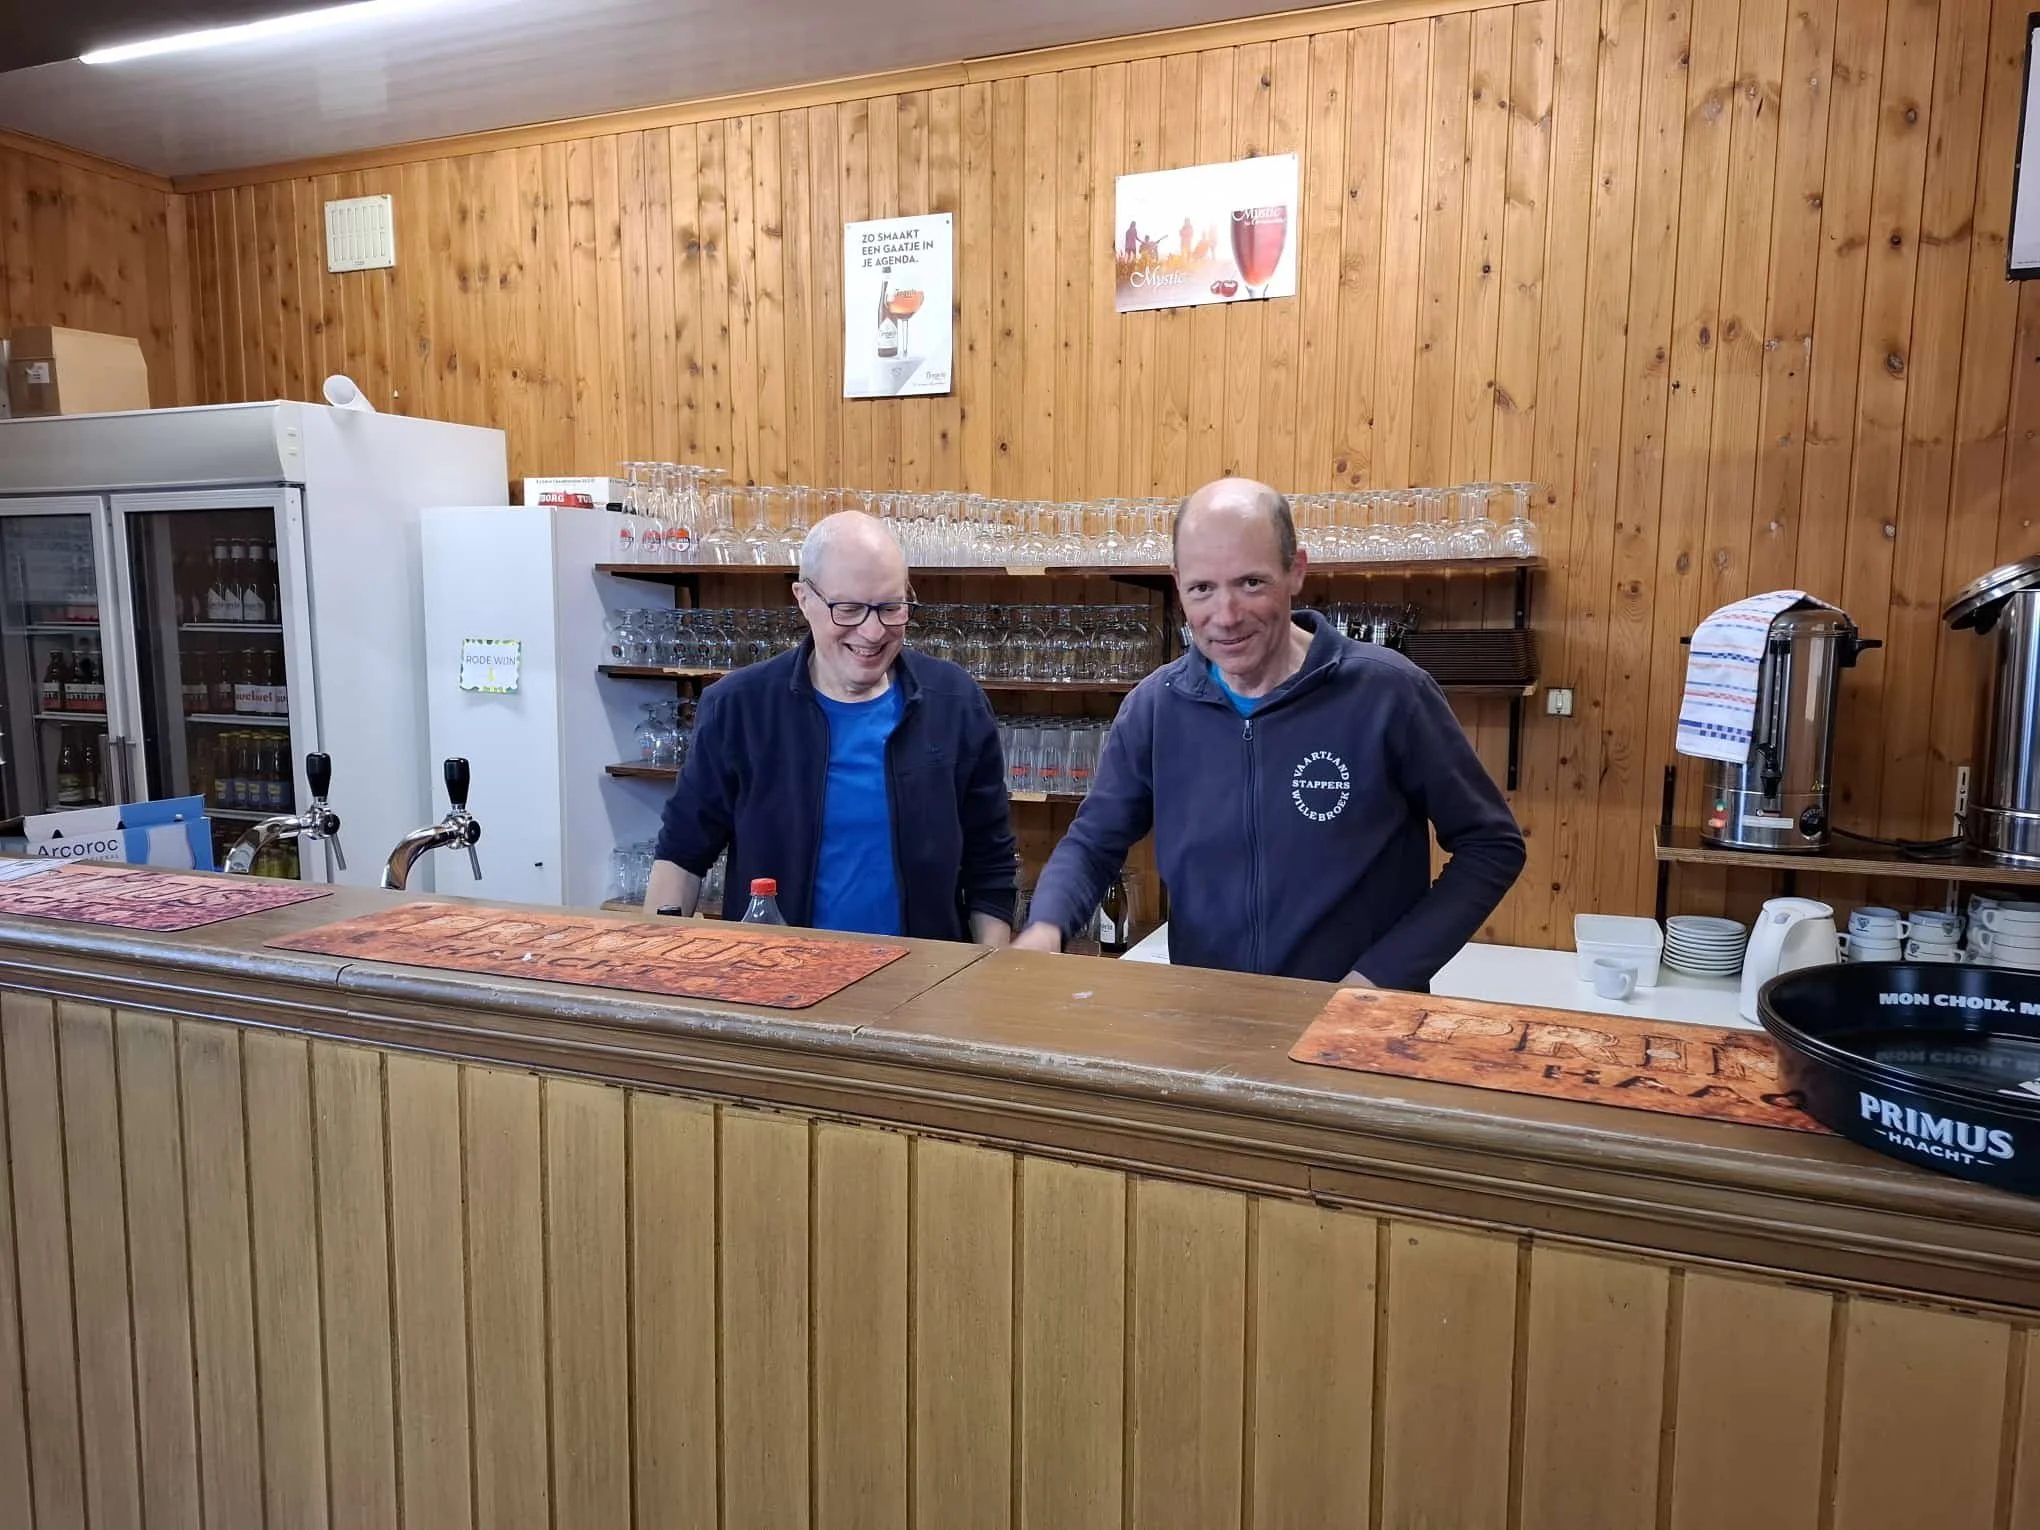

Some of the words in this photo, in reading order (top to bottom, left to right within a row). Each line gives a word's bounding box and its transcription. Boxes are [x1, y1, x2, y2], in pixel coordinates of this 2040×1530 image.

[862, 233, 876, 244] ZO
[877, 229, 920, 242] SMAAKT
[861, 245, 881, 256] EEN
[882, 241, 920, 254] GAATJE
[922, 240, 934, 251] IN
[861, 258, 873, 268] JE
[875, 254, 919, 266] AGENDA.
[1129, 265, 1187, 289] Mystic
[466, 655, 492, 665] RODE
[1293, 750, 1350, 781] VAARTLAND
[1292, 779, 1351, 790] STAPPERS
[1292, 789, 1350, 822] WILLEBROEK
[38, 839, 119, 858] Arcoroc
[384, 913, 818, 970] PRIMUS
[1879, 992, 1930, 1006] MON
[1934, 993, 2015, 1012] CHOIX.
[1859, 1091, 2015, 1160] PRIMUS
[1889, 1132, 1975, 1165] HAACHT
